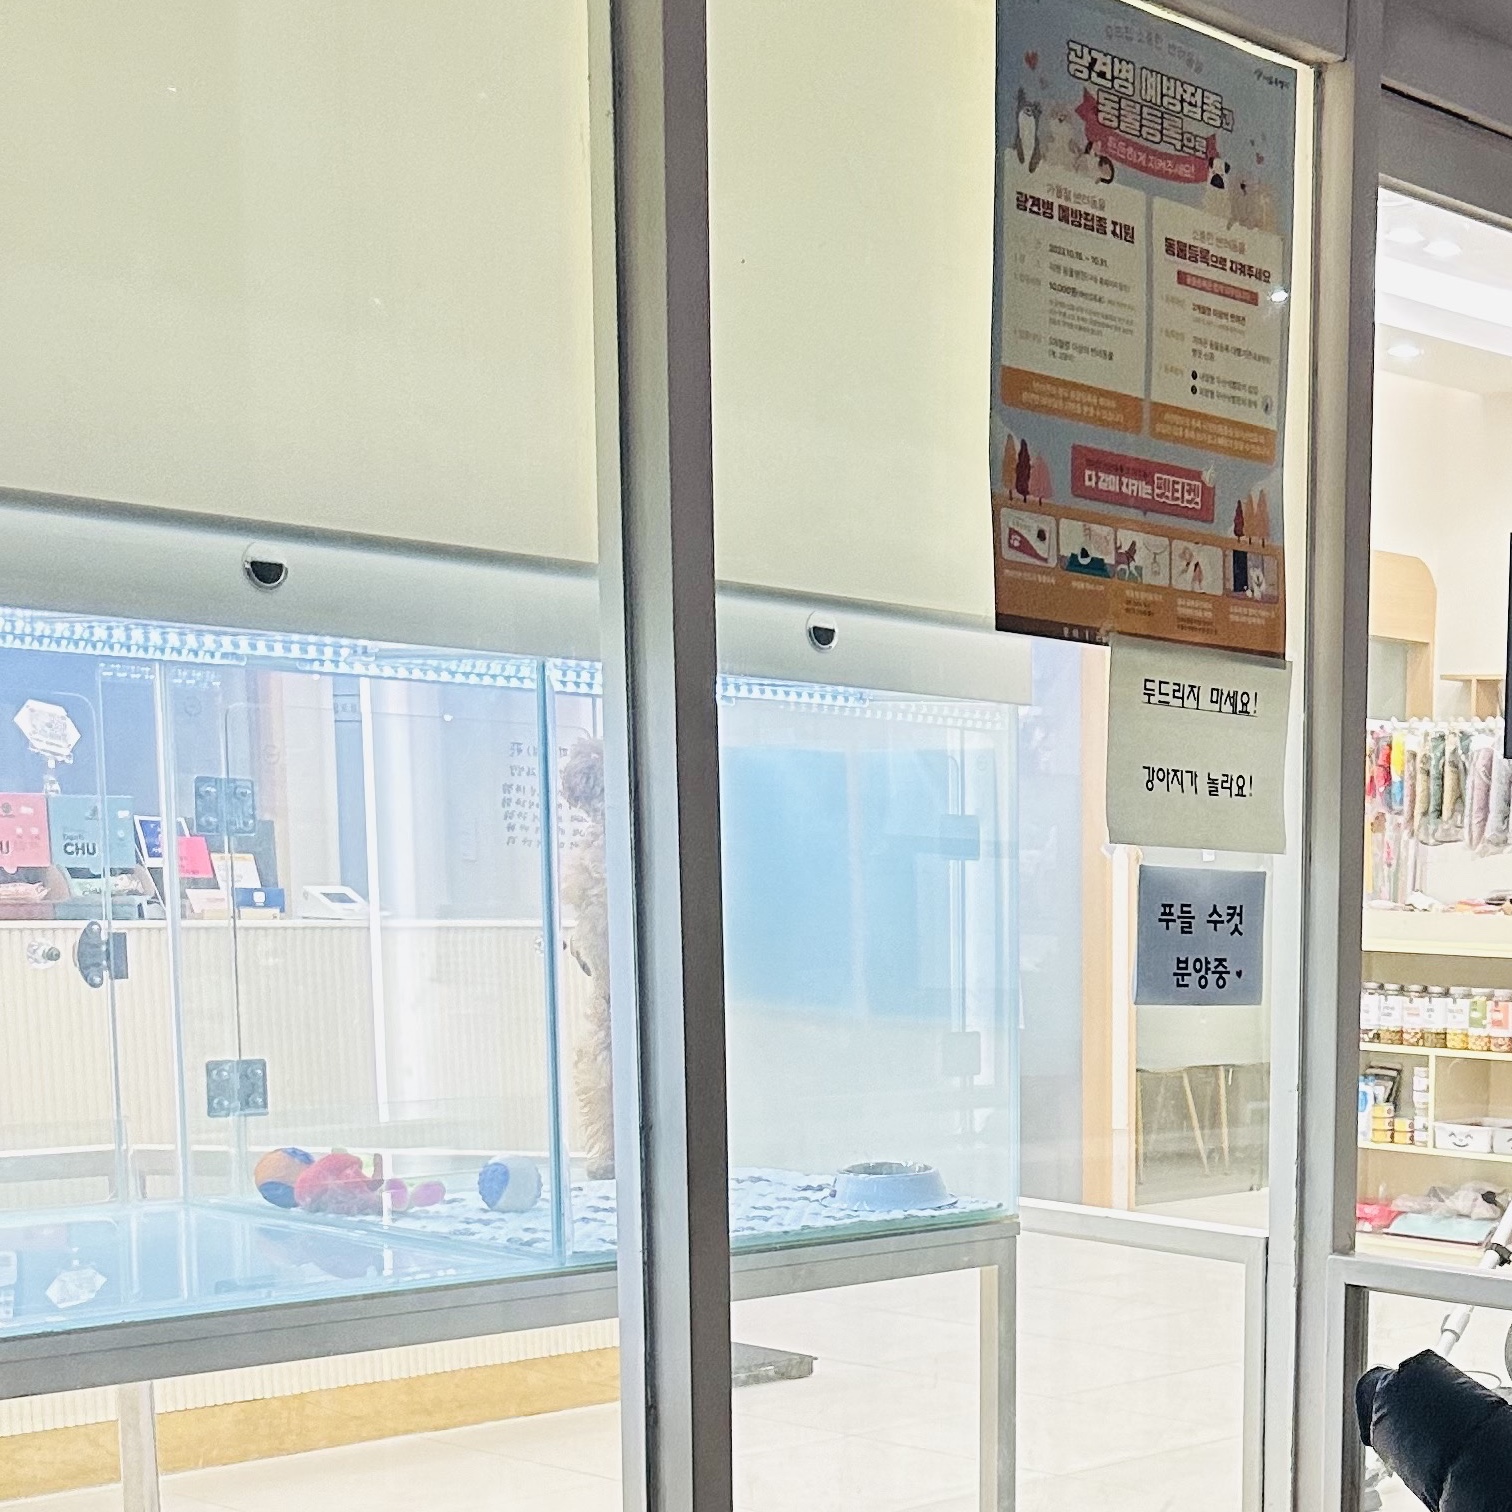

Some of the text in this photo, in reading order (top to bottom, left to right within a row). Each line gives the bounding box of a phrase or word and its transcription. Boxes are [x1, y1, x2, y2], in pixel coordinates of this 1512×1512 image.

[1066, 39, 1135, 97] 광견병
[1097, 88, 1207, 157] 동물등록으로
[1016, 190, 1135, 244] 광견병 예방접종 지원
[1164, 236, 1272, 284] 동물등록으로 지켜주세요
[1084, 469, 1097, 488] 다
[1098, 471, 1120, 493] 같이
[1121, 477, 1153, 499] 지키는
[1154, 473, 1202, 510] 펫티켓
[1142, 678, 1258, 715] 두드리지 마세요!
[1142, 765, 1253, 798] 강아지가 놀라요!
[63, 842, 97, 856] CHU
[1158, 902, 1244, 937] 푸들 수컷
[1172, 957, 1231, 989] 분양중
